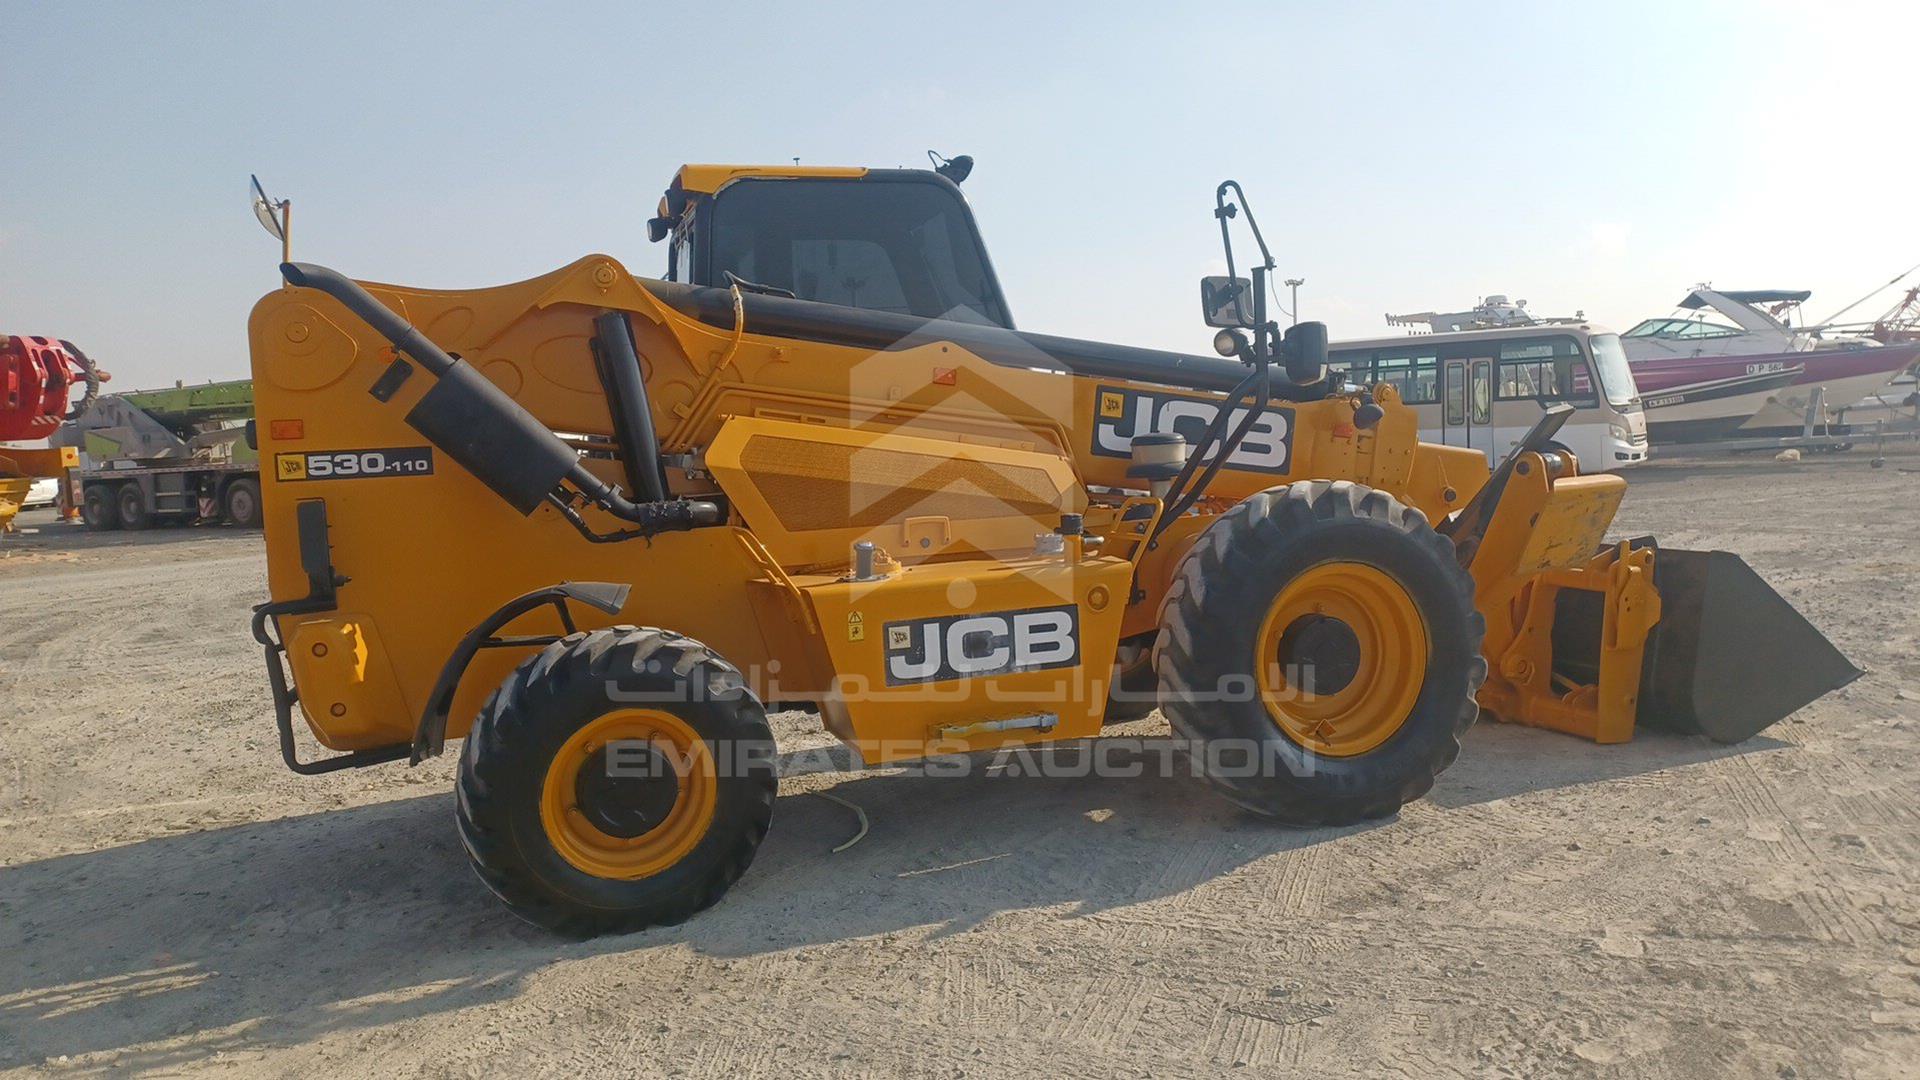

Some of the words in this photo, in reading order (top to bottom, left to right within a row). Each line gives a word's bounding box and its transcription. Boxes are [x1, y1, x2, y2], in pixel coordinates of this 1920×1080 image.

[307, 452, 428, 476] 530-110
[1098, 396, 1288, 468] JCB
[890, 611, 1076, 680] JCB
